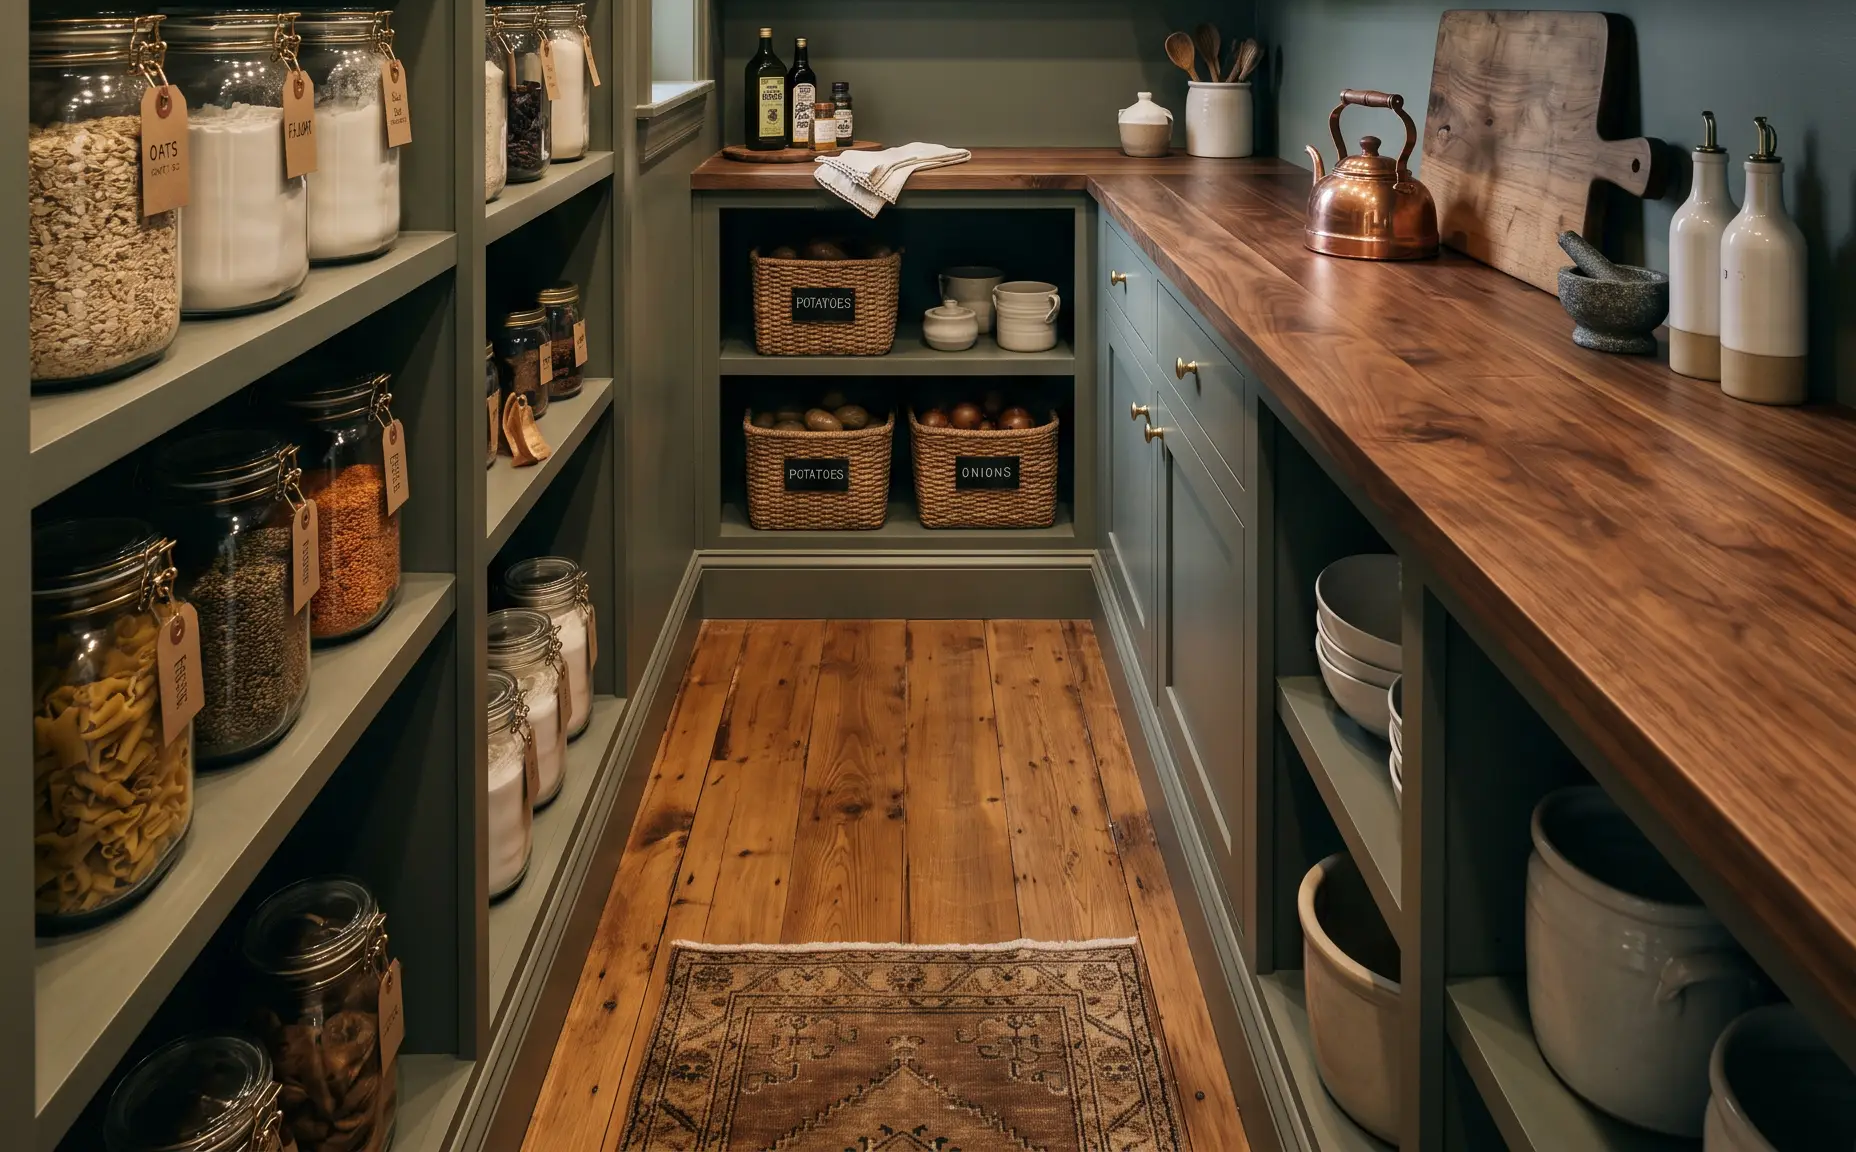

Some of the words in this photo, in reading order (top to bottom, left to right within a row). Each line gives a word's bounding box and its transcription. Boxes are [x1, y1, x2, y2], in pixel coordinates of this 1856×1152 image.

[150, 140, 178, 161] OATS
[789, 469, 844, 480] POTATOES
[962, 466, 1012, 478] ONIONS
